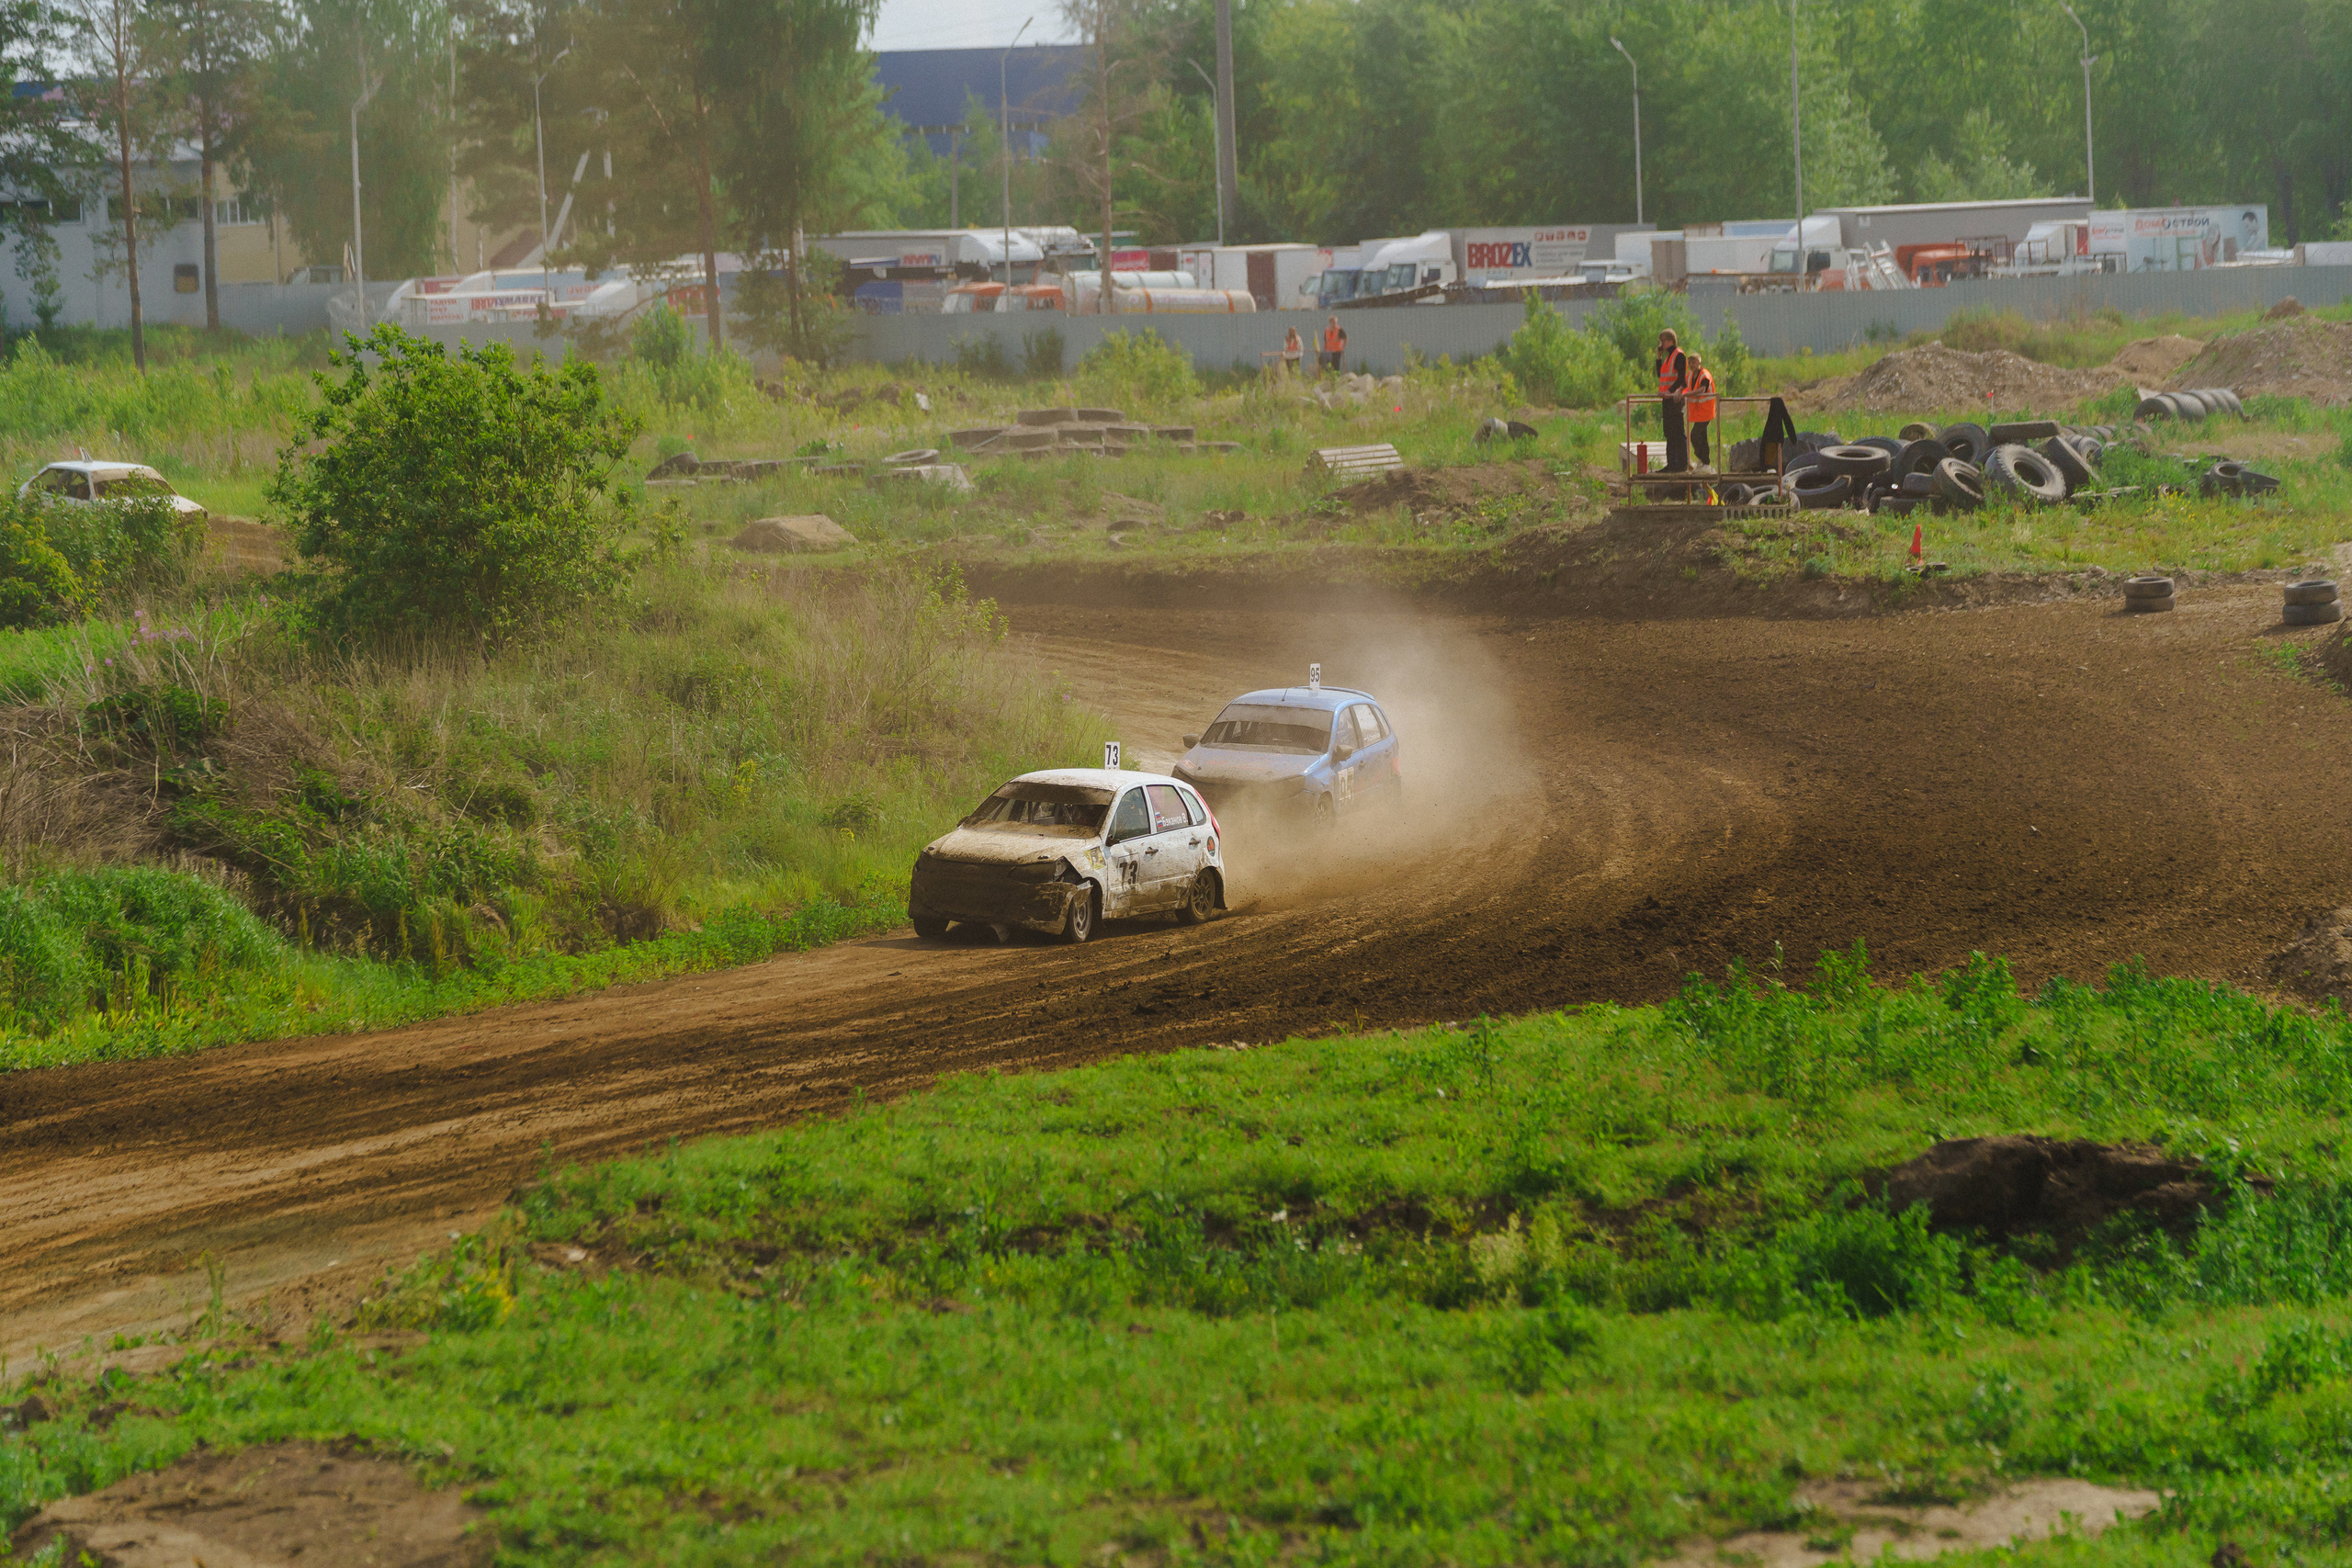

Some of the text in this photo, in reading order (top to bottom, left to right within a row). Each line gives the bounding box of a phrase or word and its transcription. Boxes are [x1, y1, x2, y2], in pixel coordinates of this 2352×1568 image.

[1467, 243, 1532, 268] BROZEX
[1310, 667, 1320, 682] 95
[1105, 744, 1119, 766] 73
[1119, 860, 1138, 891] 73
